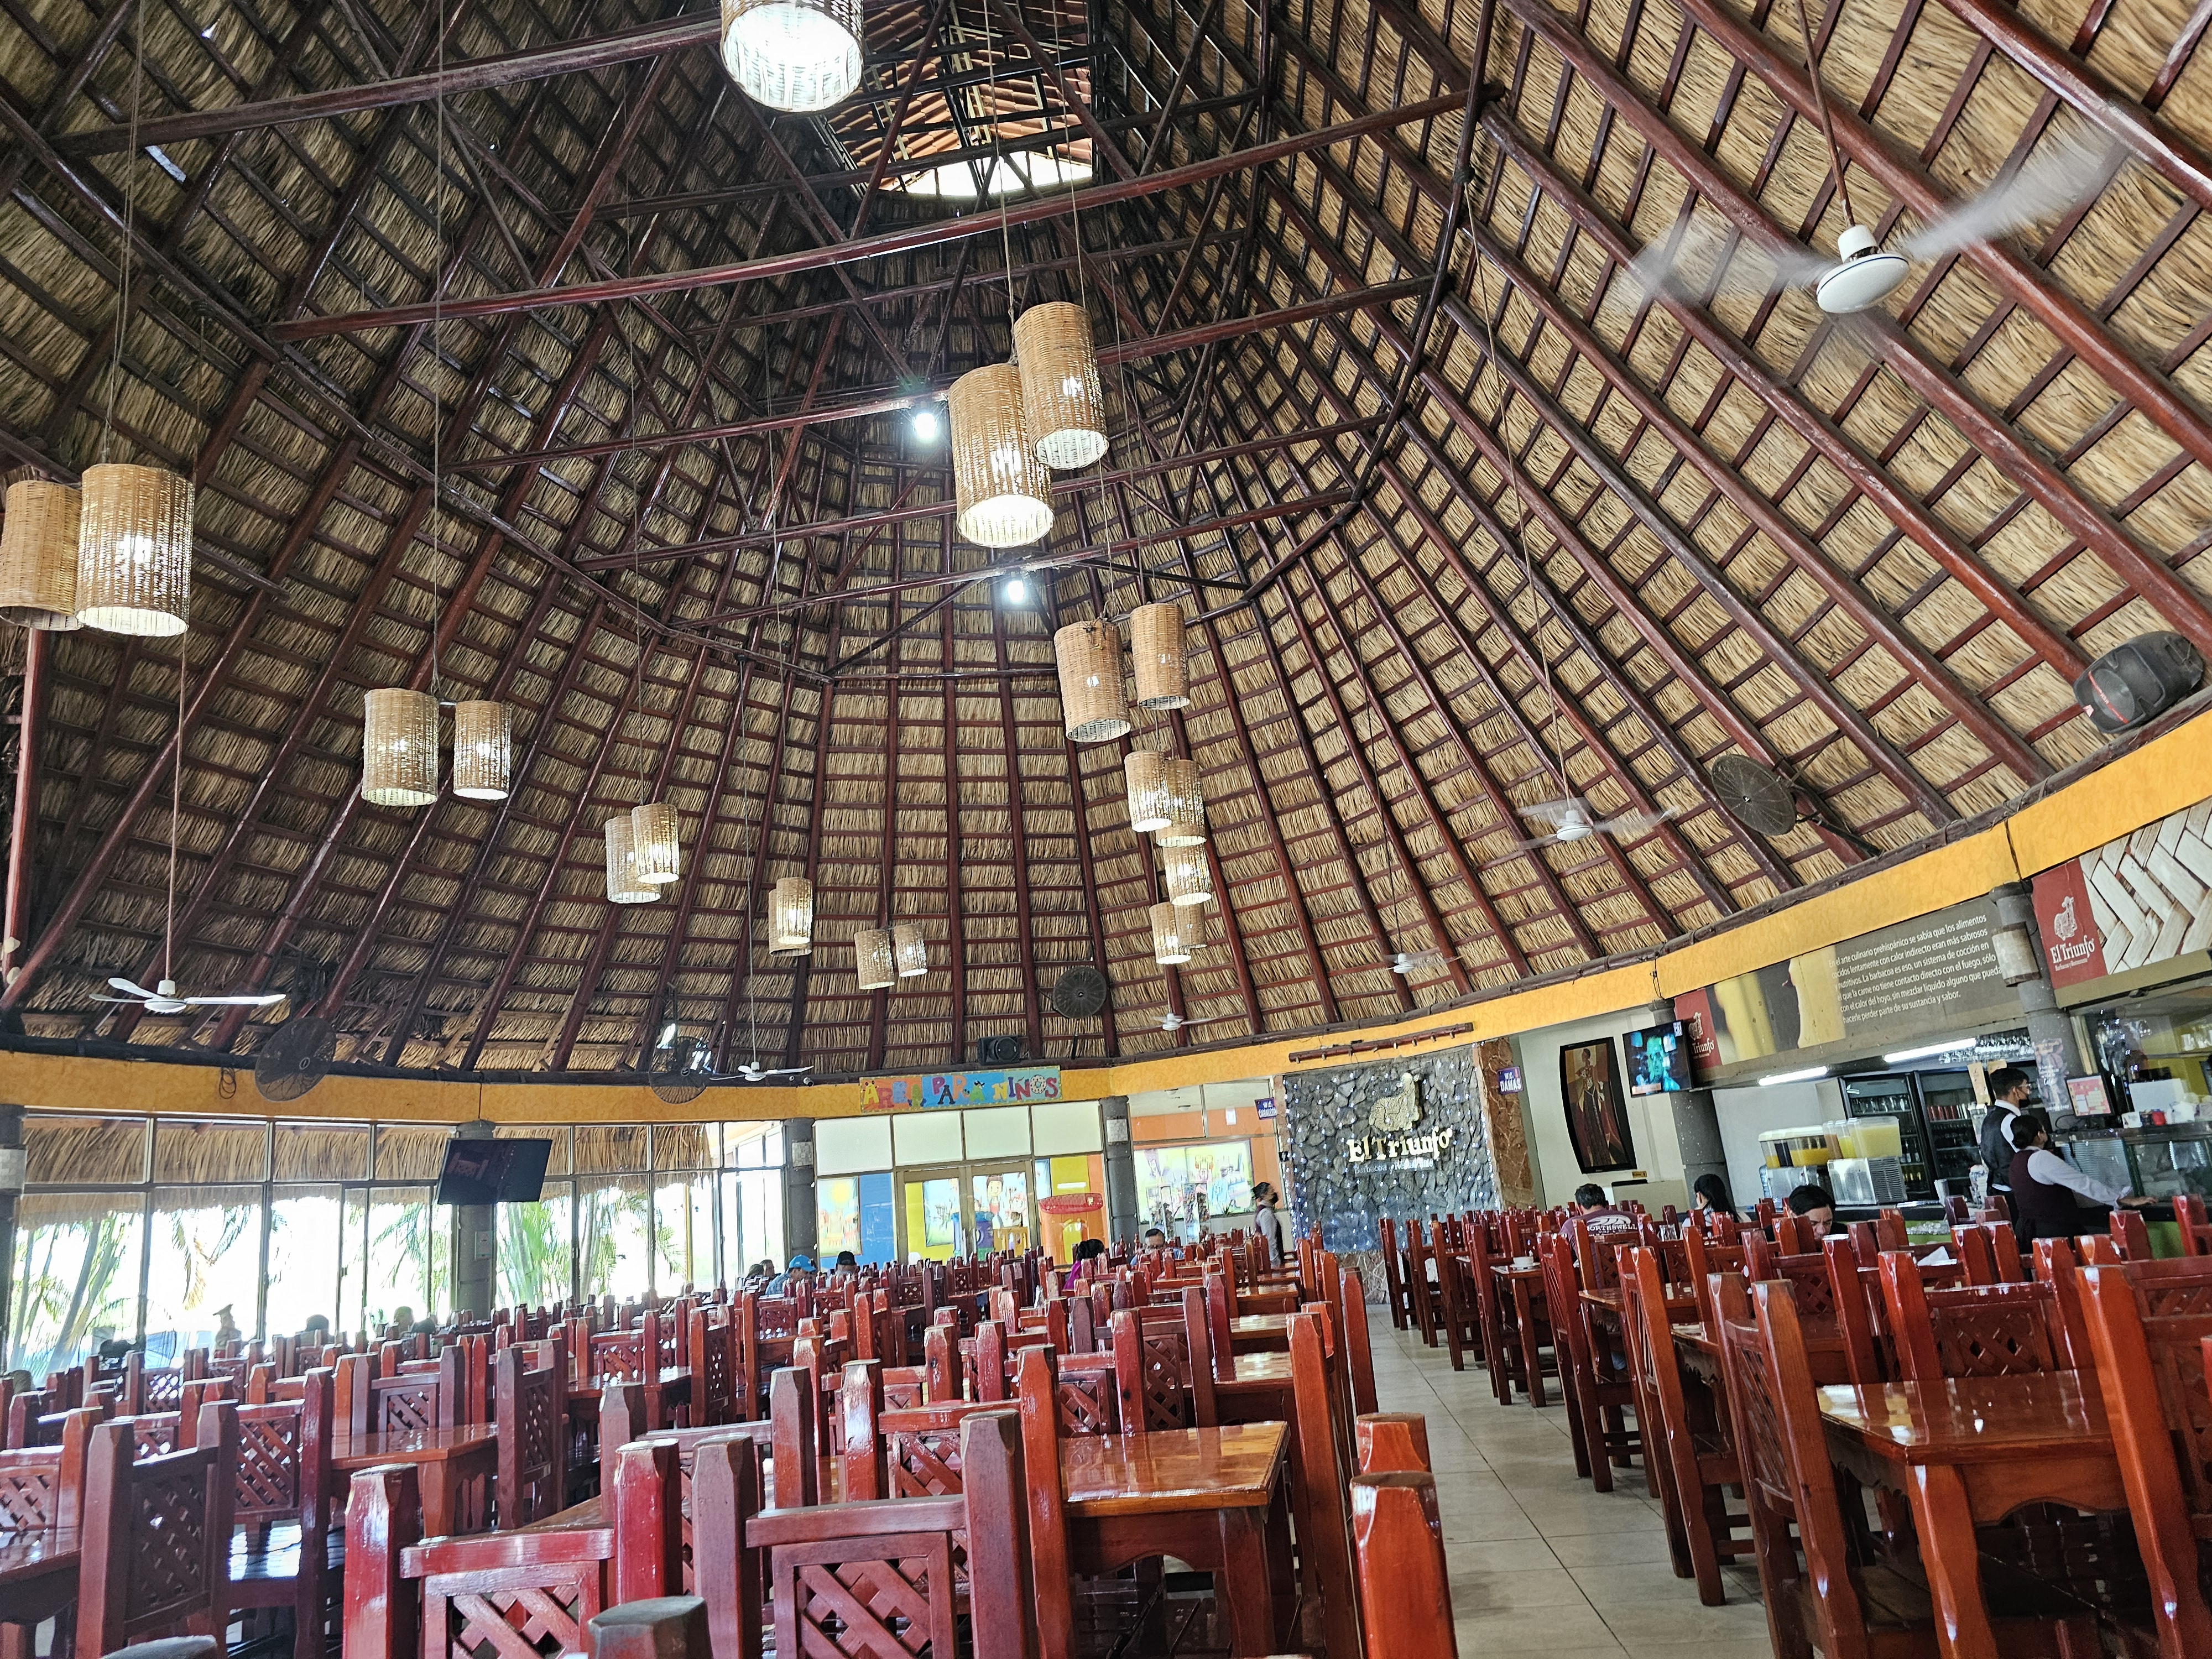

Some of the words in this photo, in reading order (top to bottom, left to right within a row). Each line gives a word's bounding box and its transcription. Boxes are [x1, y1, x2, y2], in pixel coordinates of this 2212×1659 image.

[1829, 959, 1836, 968] En
[1836, 957, 1841, 966] el
[1841, 955, 1851, 964] arte
[1851, 948, 1873, 961] culinario
[1874, 938, 1908, 956] prehispánico
[1909, 936, 1917, 944] se
[1917, 930, 1932, 942] sabía
[1933, 927, 1945, 938] que
[1945, 924, 1955, 933] los
[1955, 915, 1987, 930] alimentos
[1832, 968, 1850, 979] cocidos
[1850, 959, 1880, 973] lentamente
[1880, 956, 1890, 965] con
[1891, 952, 1904, 962] calor
[1905, 944, 1932, 958] indirecto
[1932, 941, 1946, 951] eran
[1947, 935, 1960, 946] más
[1960, 928, 1988, 942] sabrosos
[2050, 944, 2062, 964] El
[2059, 935, 2095, 961] Triunfo
[1838, 977, 1863, 989] nutritivos.
[1862, 974, 1869, 983] La
[1869, 968, 1895, 980] barbacoa
[1894, 966, 1901, 974] es
[1902, 963, 1913, 972] eso,
[1913, 959, 1923, 968] un
[1922, 953, 1947, 967] sistema
[1947, 950, 1956, 959] de
[1956, 943, 1980, 957] cocción
[1980, 942, 1990, 951] en
[1838, 993, 1843, 1001] el
[1842, 993, 1853, 1001] que
[1858, 987, 1872, 996] carne
[1872, 984, 1880, 993] no
[1880, 981, 1894, 990] tiene
[1894, 974, 1920, 987] contacto
[1920, 968, 1942, 980] directo
[1942, 964, 1955, 974] con
[1955, 961, 1962, 971] el
[1961, 958, 1983, 969] fuego,
[1982, 953, 1996, 964] sólo
[1843, 1013, 1861, 1024] hacerle
[1861, 1010, 1879, 1022] perder
[1879, 1006, 1893, 1018] parte
[1893, 1003, 1901, 1013] de
[1901, 1003, 1909, 1011] su
[1908, 995, 1936, 1009] sustancia
[1936, 994, 1941, 1004] y
[1941, 991, 1961, 1001] sabor.
[1850, 1001, 1855, 1010] el
[1855, 1000, 1868, 1009] calor
[1868, 996, 1877, 1006] del
[1876, 994, 1892, 1004] hoyo,
[1892, 991, 1901, 1000] sin
[1901, 985, 1923, 998] mezclar
[1923, 979, 1945, 993] líquido
[1945, 977, 1968, 988] alguno
[1969, 974, 1982, 983] que
[1692, 1037, 1714, 1054] Triunfo
[932, 1074, 985, 1105] PARA
[991, 1074, 1058, 1100] NIÑOS
[1500, 1077, 1521, 1092] DAMAS
[1346, 1135, 1372, 1163] El
[1371, 1126, 1450, 1160] Triunfo
